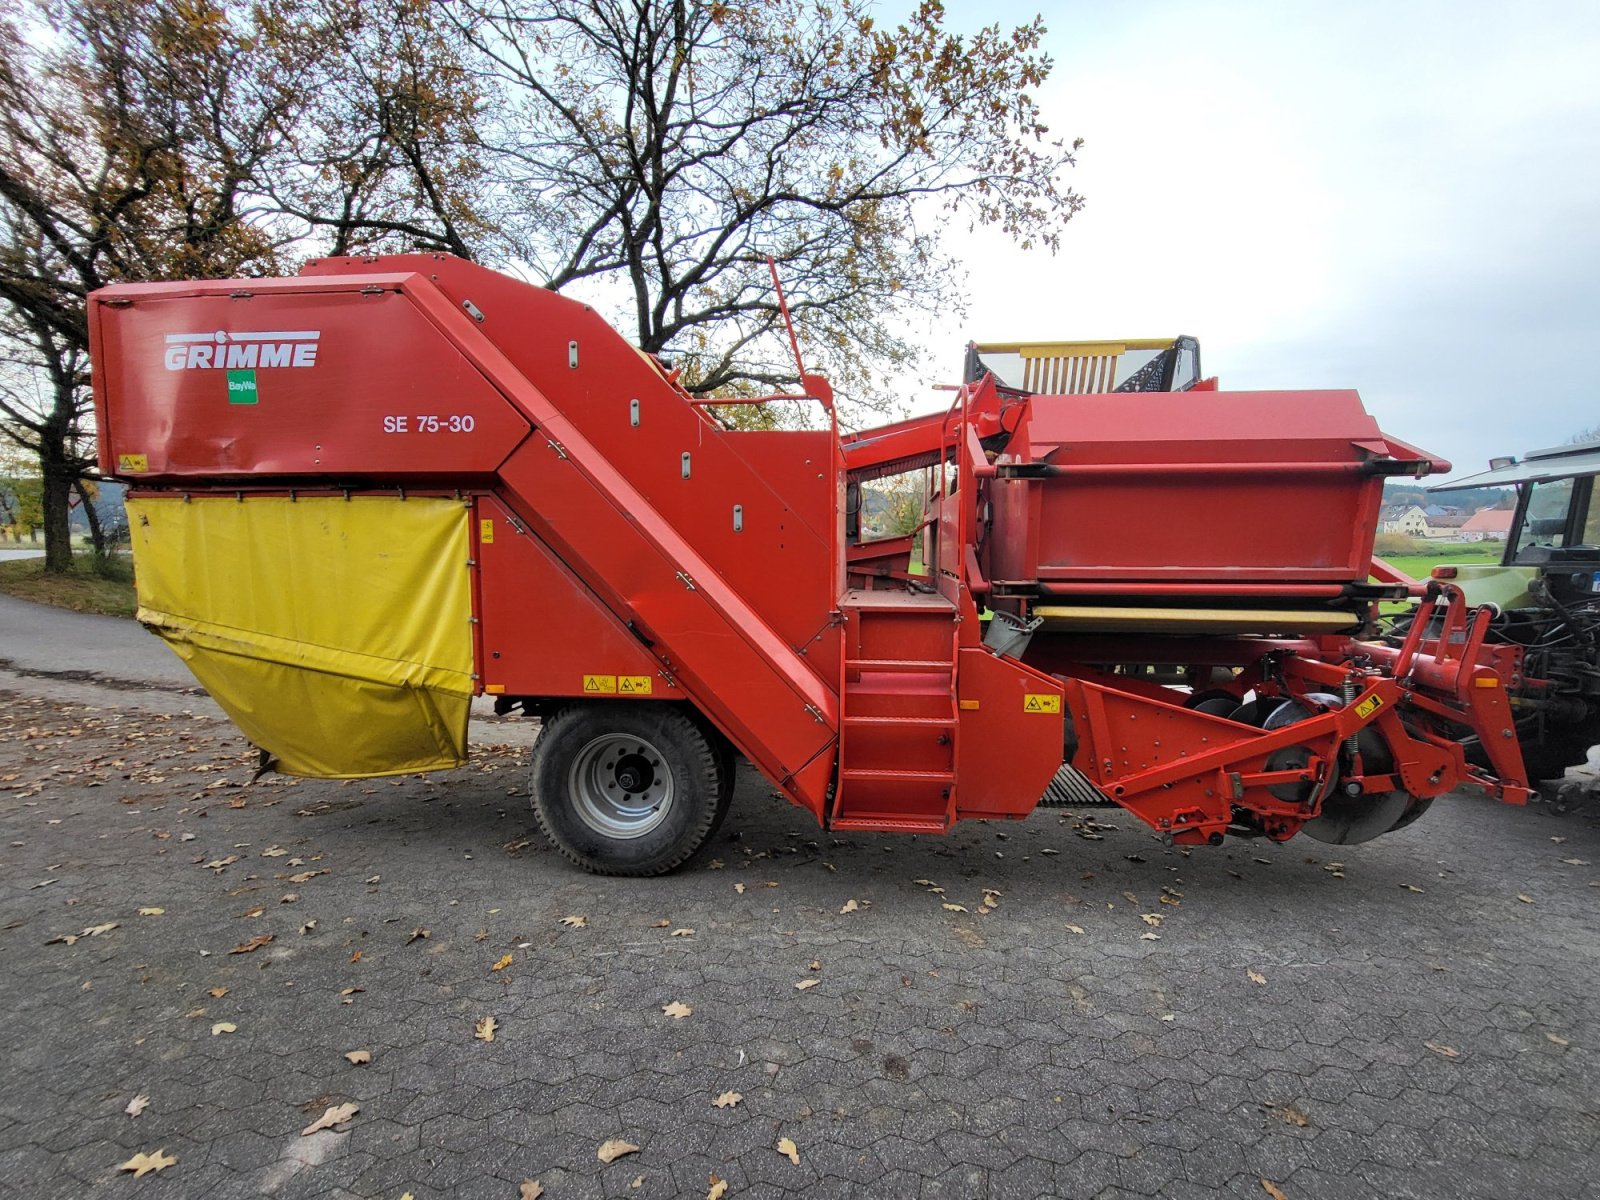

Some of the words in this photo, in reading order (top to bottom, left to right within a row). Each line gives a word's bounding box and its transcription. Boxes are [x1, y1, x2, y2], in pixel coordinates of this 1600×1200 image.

[164, 331, 319, 371] GRIMME
[229, 381, 256, 391] BayWa
[383, 415, 408, 433] SE
[416, 415, 475, 433] 75-30
